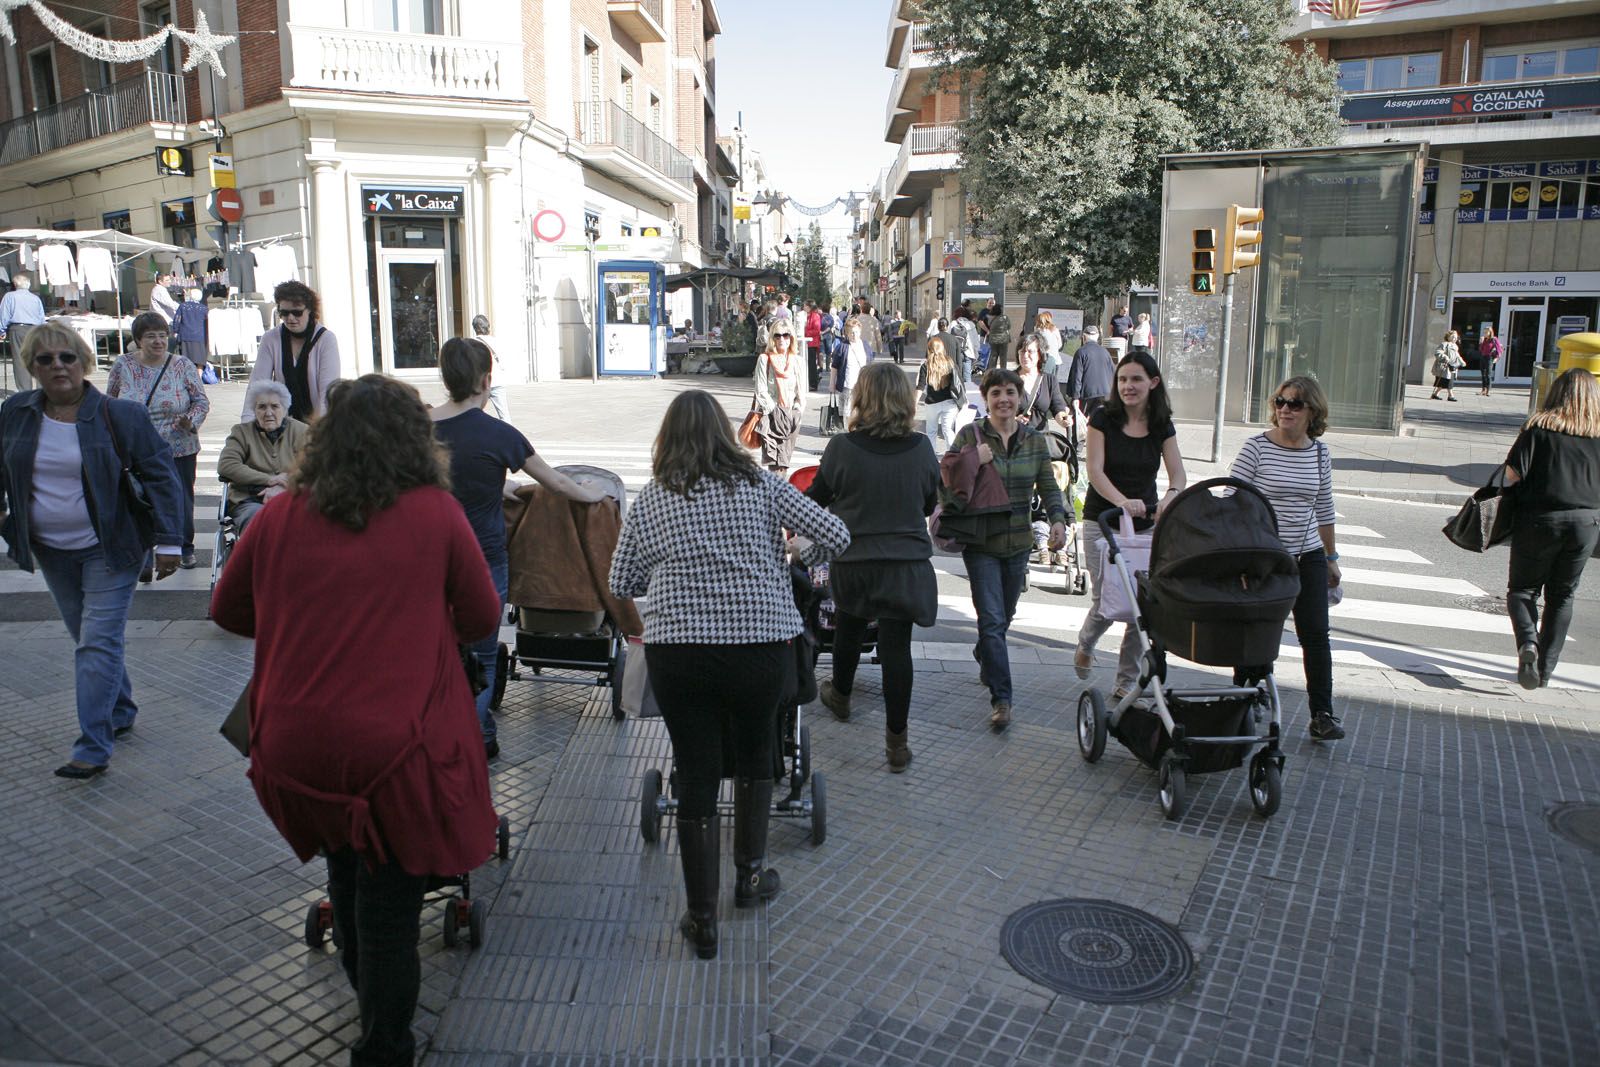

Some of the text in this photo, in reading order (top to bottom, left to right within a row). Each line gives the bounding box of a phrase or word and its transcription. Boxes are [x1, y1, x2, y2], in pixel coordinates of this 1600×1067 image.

[1473, 89, 1545, 102] CATALANA
[1383, 97, 1451, 109] Assegurances
[1472, 99, 1545, 112] OCCIDENT
[1498, 168, 1528, 178] Sabat
[1547, 165, 1578, 176] Sabat
